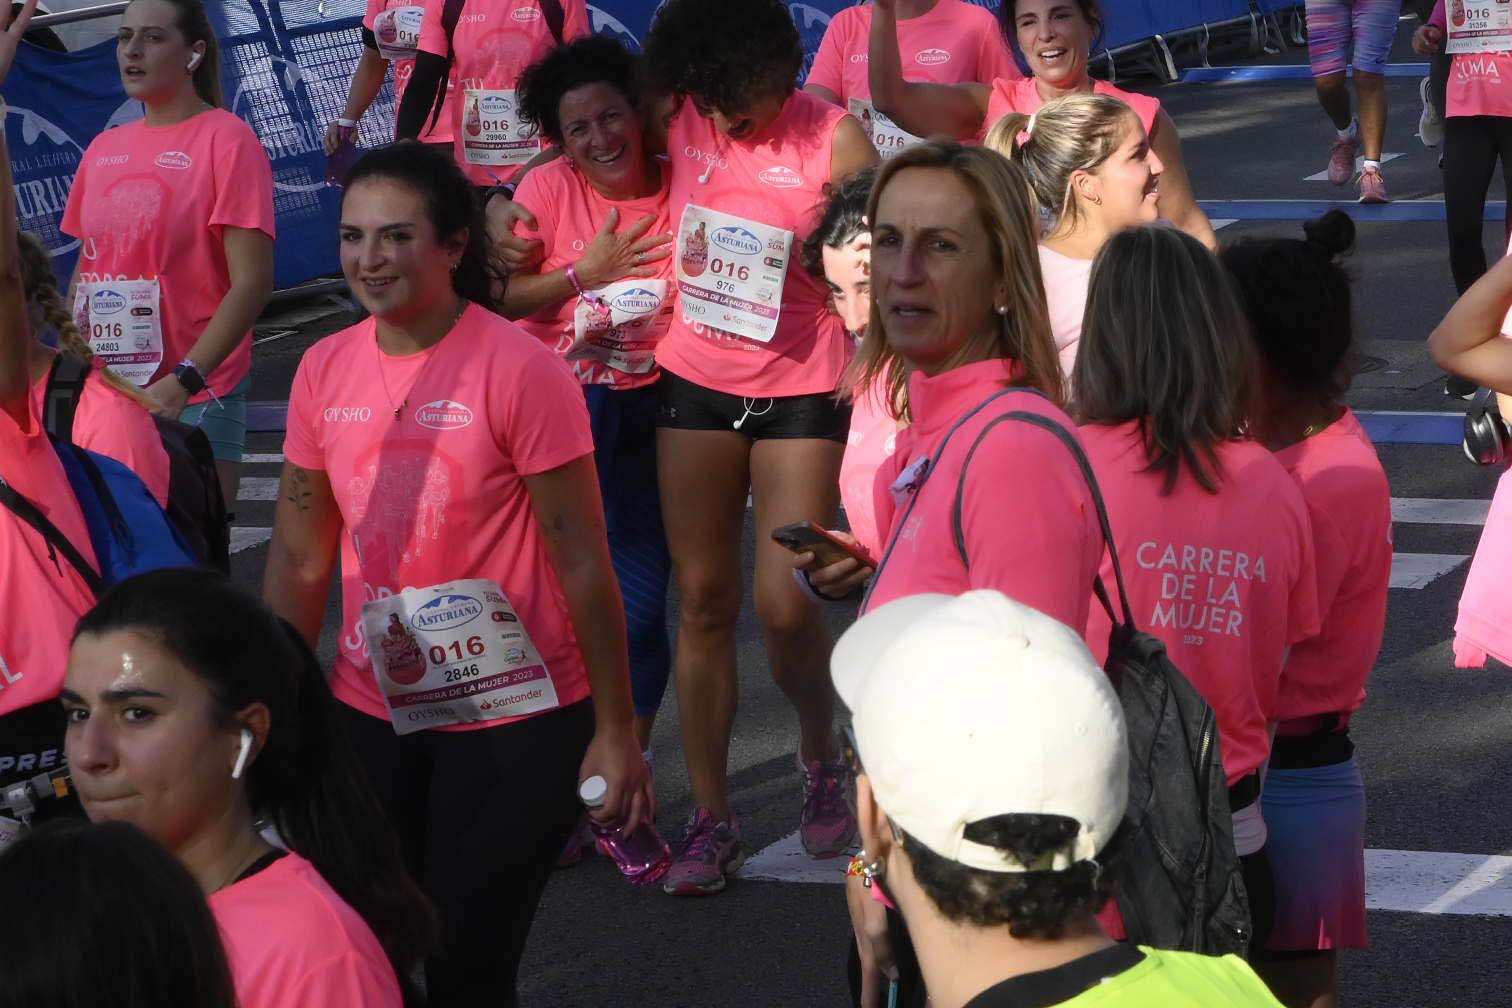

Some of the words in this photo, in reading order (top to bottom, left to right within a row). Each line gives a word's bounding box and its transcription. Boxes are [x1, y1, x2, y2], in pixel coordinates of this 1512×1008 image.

[1466, 8, 1490, 20] 016
[482, 120, 509, 131] 016
[876, 133, 905, 147] 016
[710, 258, 750, 281] 016
[716, 280, 735, 294] 976
[93, 323, 122, 338] 016
[324, 407, 371, 422] OYSHO
[420, 411, 469, 424] ASTURIANA
[1136, 542, 1267, 583] CARRERA
[1162, 572, 1197, 601] DE
[1207, 576, 1241, 608] LA
[418, 604, 479, 628] ASTURIANA
[1151, 600, 1243, 637] MUJER
[428, 635, 485, 666] 016
[444, 663, 480, 683] 2846
[449, 687, 463, 698] DE
[464, 684, 477, 693] LA
[478, 677, 509, 691] MUJER
[492, 688, 544, 709] Santander
